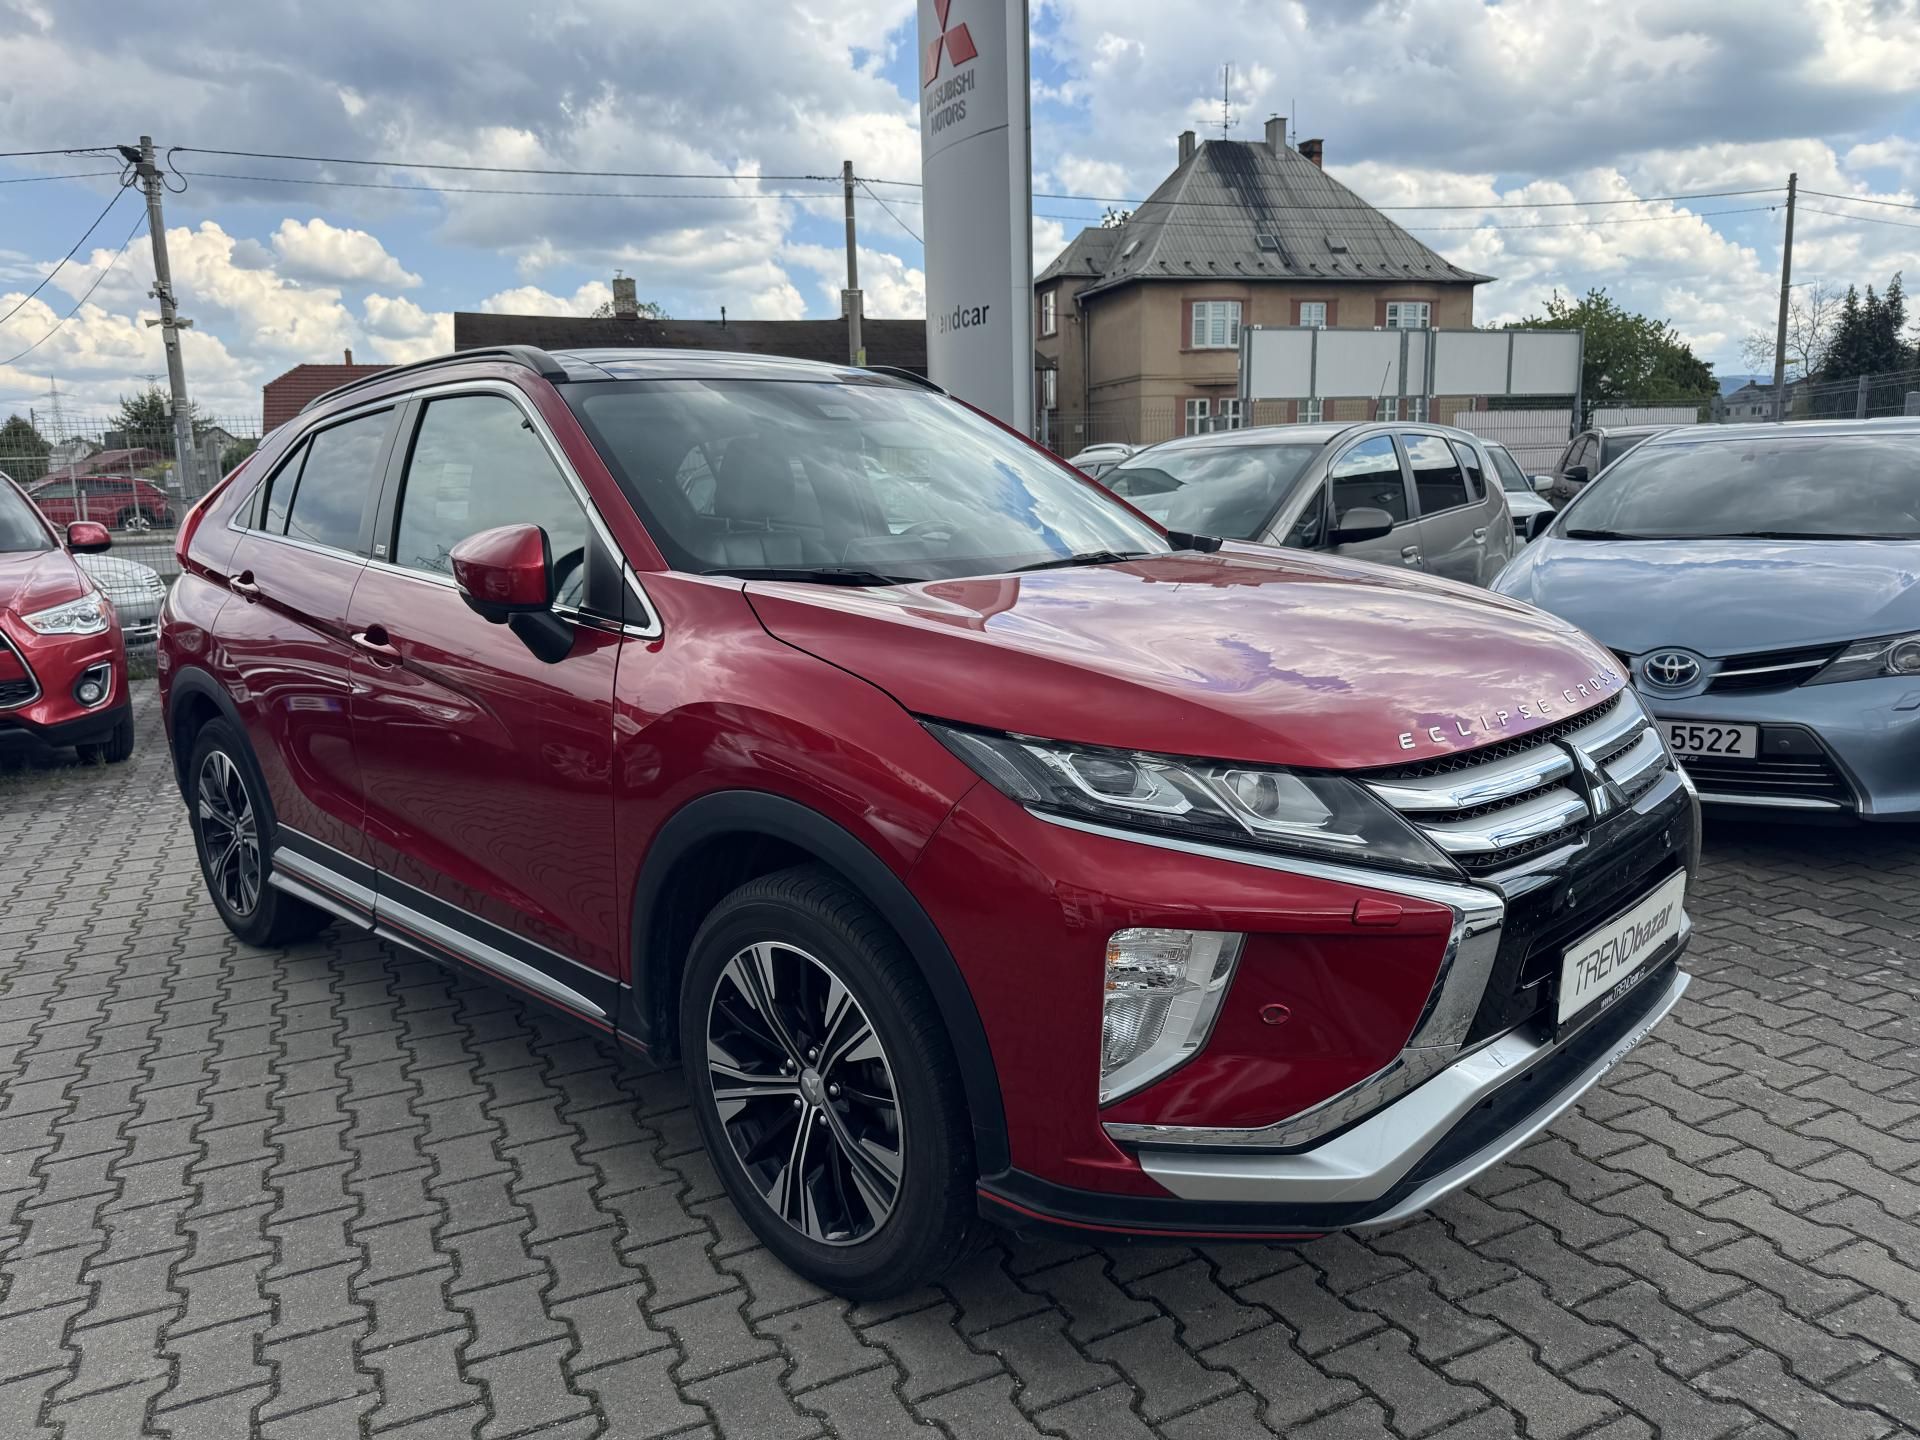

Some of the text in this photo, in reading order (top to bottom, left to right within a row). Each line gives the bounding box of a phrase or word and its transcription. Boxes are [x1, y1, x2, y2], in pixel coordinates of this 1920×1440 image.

[931, 99, 966, 136] MOTORS
[1398, 666, 1617, 749] ECLIPSE CROSS
[1670, 725, 1742, 754] 5522
[1576, 901, 1674, 996] TRENDbazar
